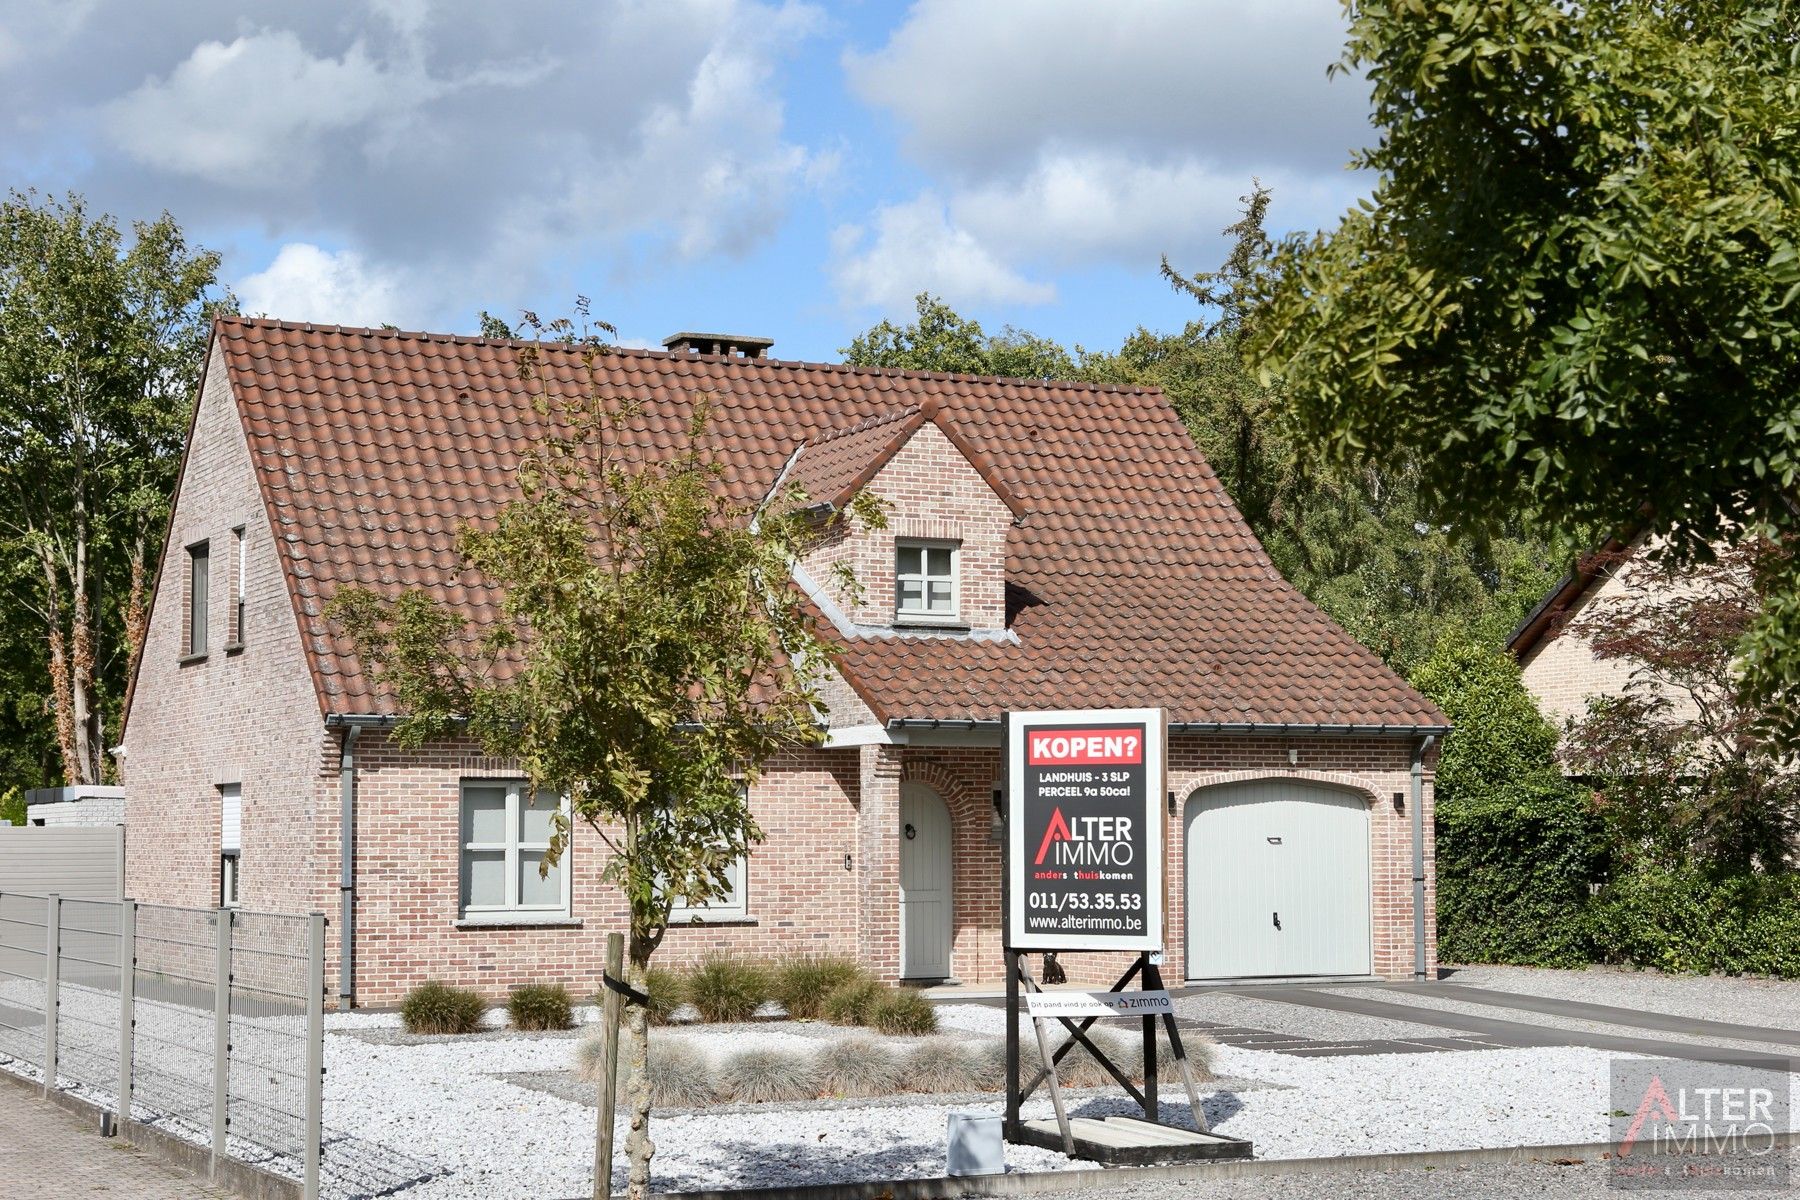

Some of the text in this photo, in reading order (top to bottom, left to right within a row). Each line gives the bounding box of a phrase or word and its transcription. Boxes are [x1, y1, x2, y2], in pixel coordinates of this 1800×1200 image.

[1033, 736, 1137, 758] KOPEN?
[1039, 773, 1092, 782] LANDHUIS
[1102, 773, 1107, 782] 3
[1111, 772, 1130, 782] SLP
[1039, 787, 1130, 796] PERCEEL 9a 50ca!
[1035, 806, 1132, 864] ALTER
[1055, 841, 1133, 866] IMMO
[1035, 871, 1133, 880] anders thuiskomen
[1030, 893, 1141, 911] 011/53.35.53
[1030, 915, 1141, 930] www.alterimmo.be
[1044, 1001, 1062, 1009] pand
